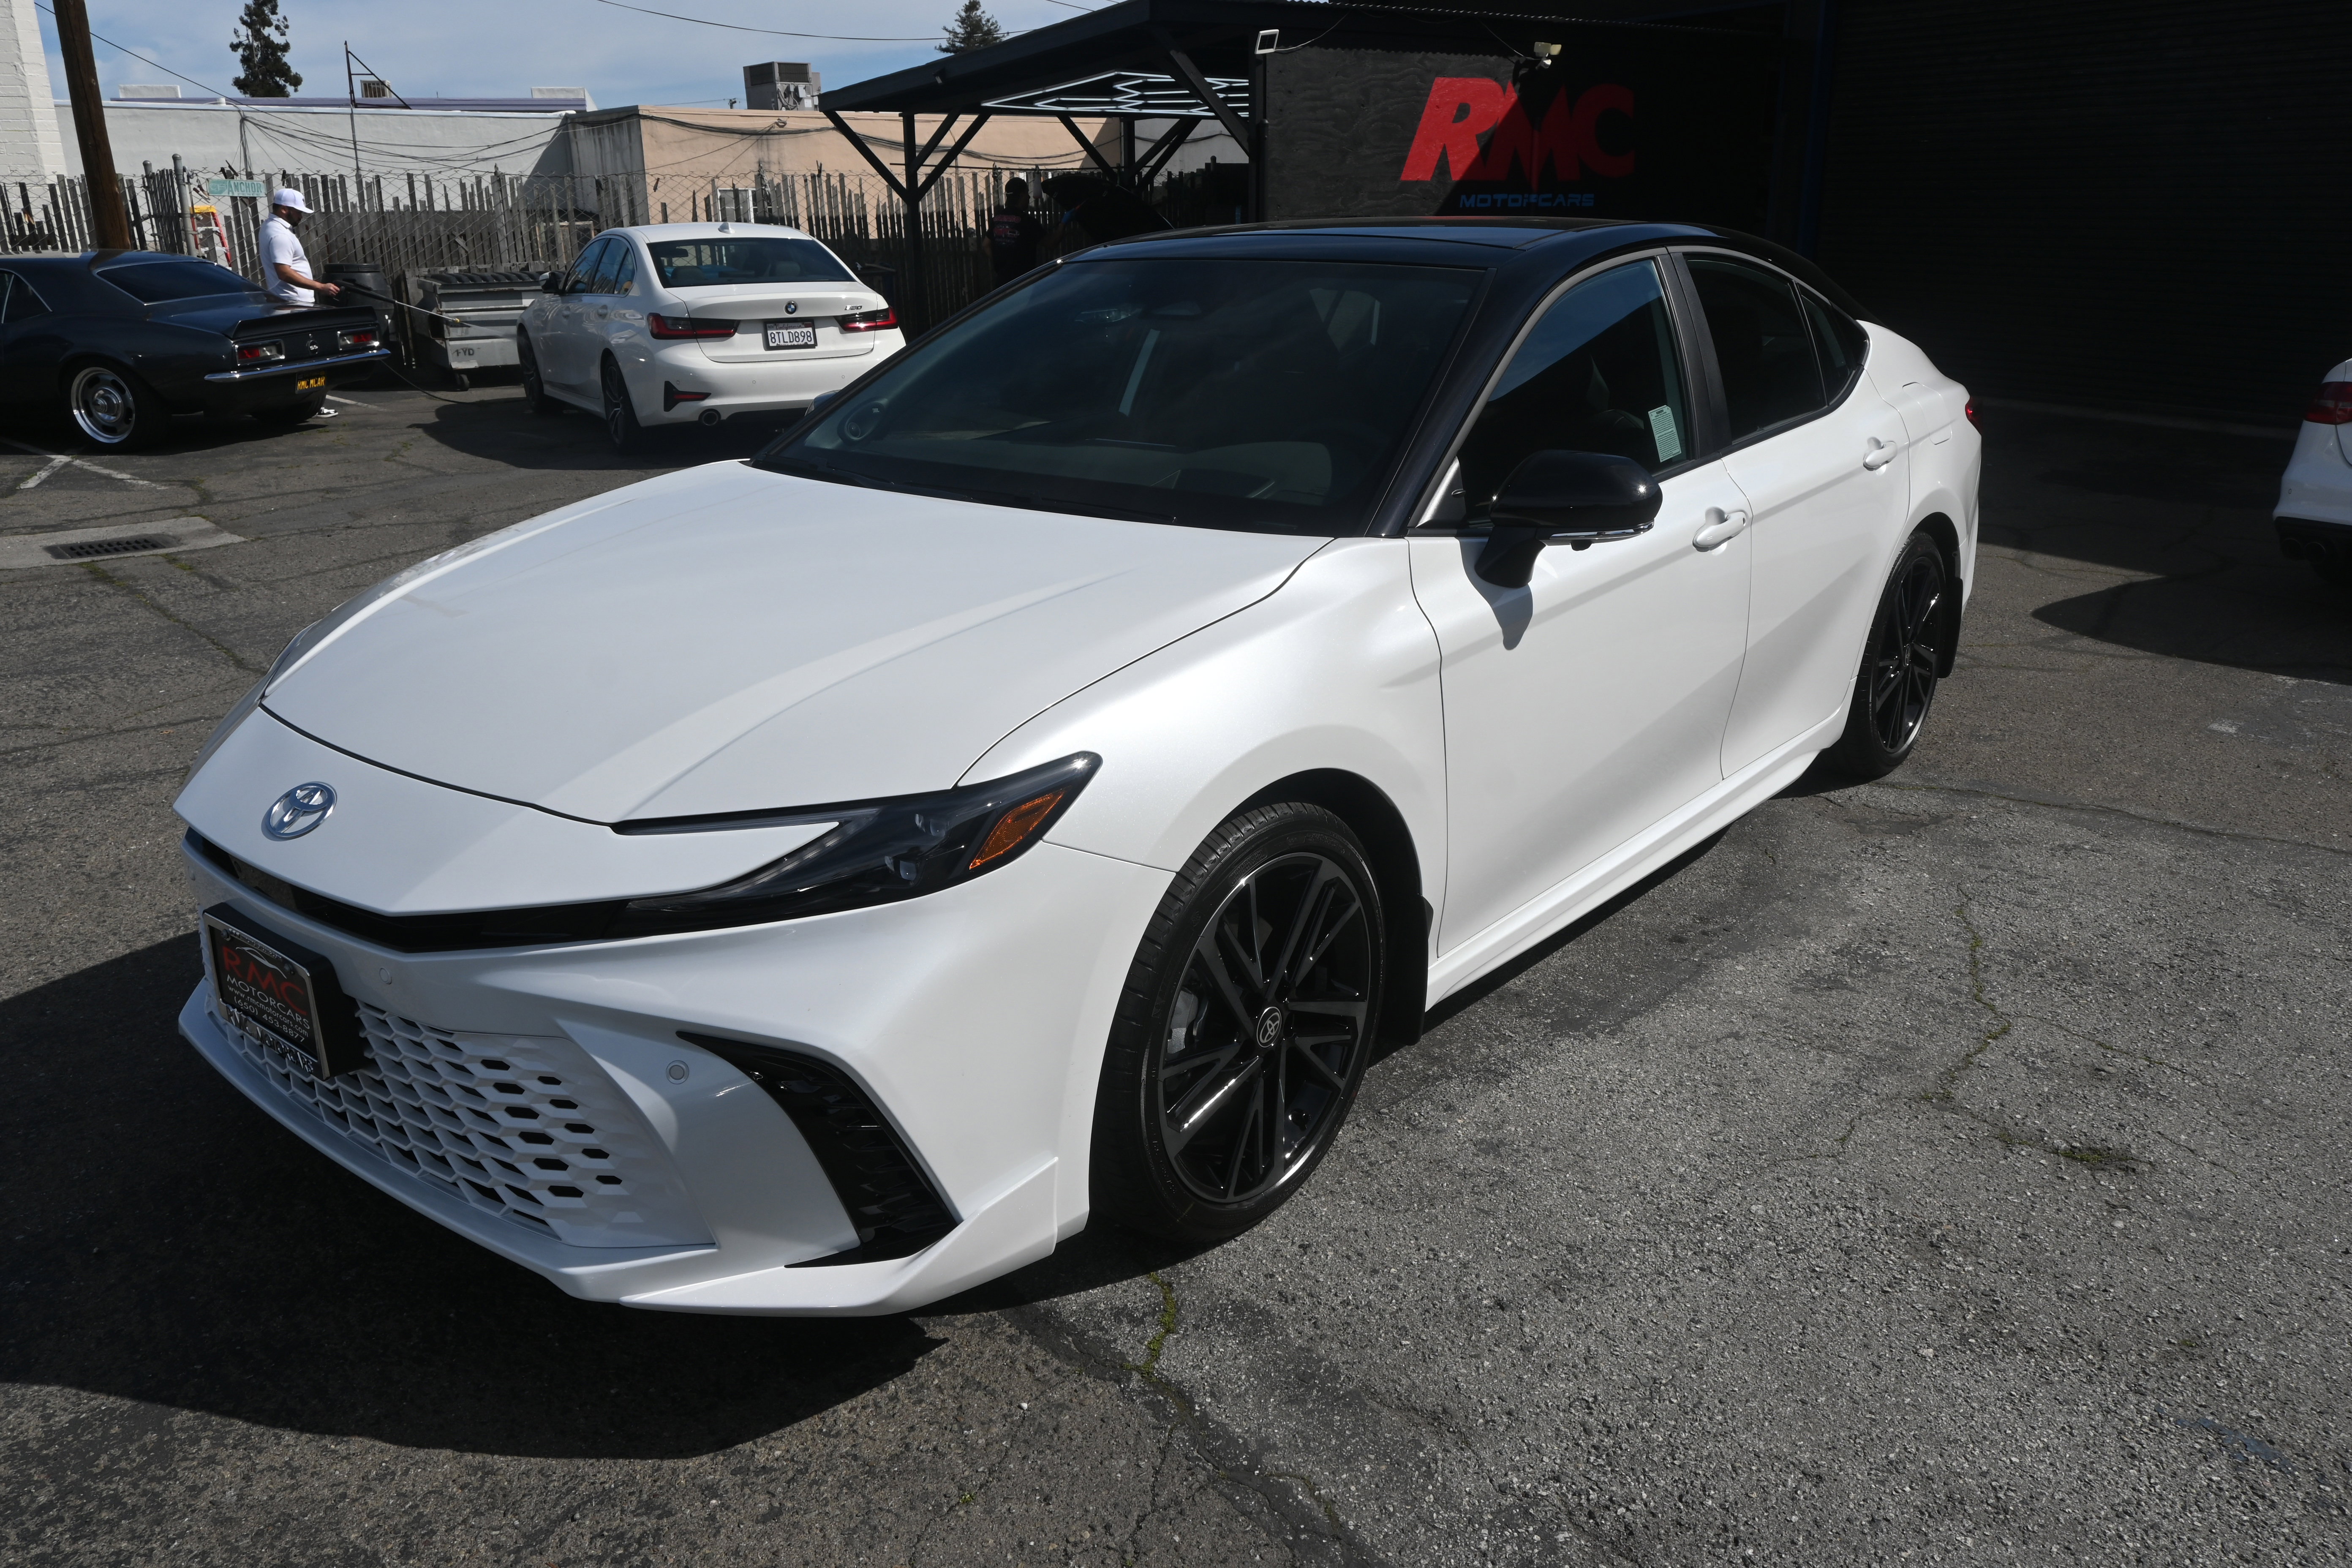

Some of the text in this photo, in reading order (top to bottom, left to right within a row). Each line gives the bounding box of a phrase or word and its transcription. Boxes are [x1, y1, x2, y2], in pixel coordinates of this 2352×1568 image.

[1400, 77, 1635, 181] RMC
[228, 180, 262, 195] ANCHOR
[1459, 193, 1595, 208] MOTORCARS
[770, 330, 812, 343] 8TLD898
[222, 946, 308, 1015] RMC
[226, 974, 310, 1029] MOTORCARS
[227, 985, 309, 1037] www.rmcmotorcars.com
[234, 996, 305, 1043] (650) 453-8877
